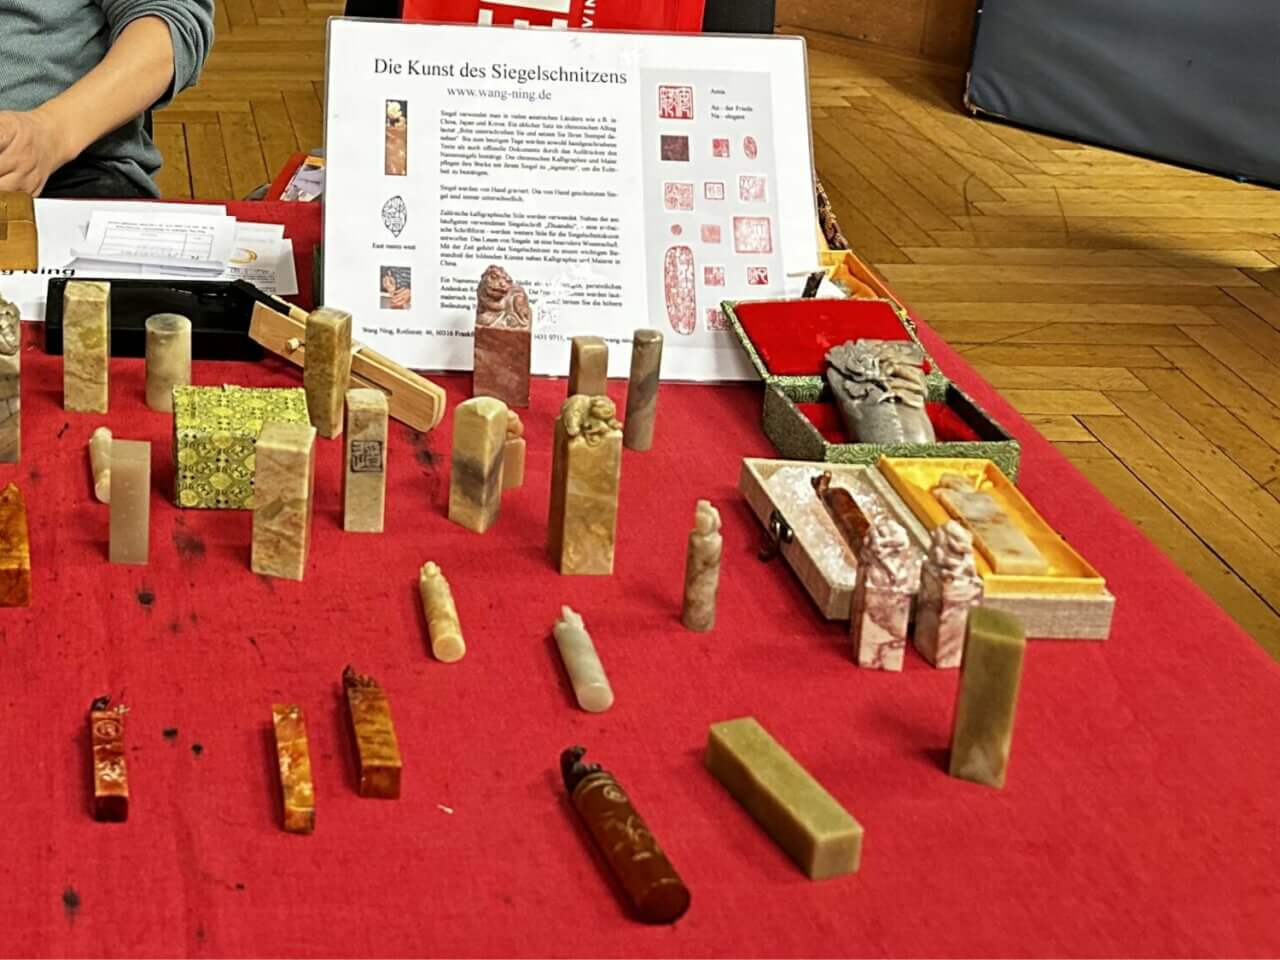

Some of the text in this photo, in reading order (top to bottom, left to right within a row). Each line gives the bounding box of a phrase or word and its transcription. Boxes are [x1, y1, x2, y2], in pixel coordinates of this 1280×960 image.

[374, 58, 627, 84] Die Kunst des Siegelschnitzens
[447, 88, 552, 102] www.wang-ning.de
